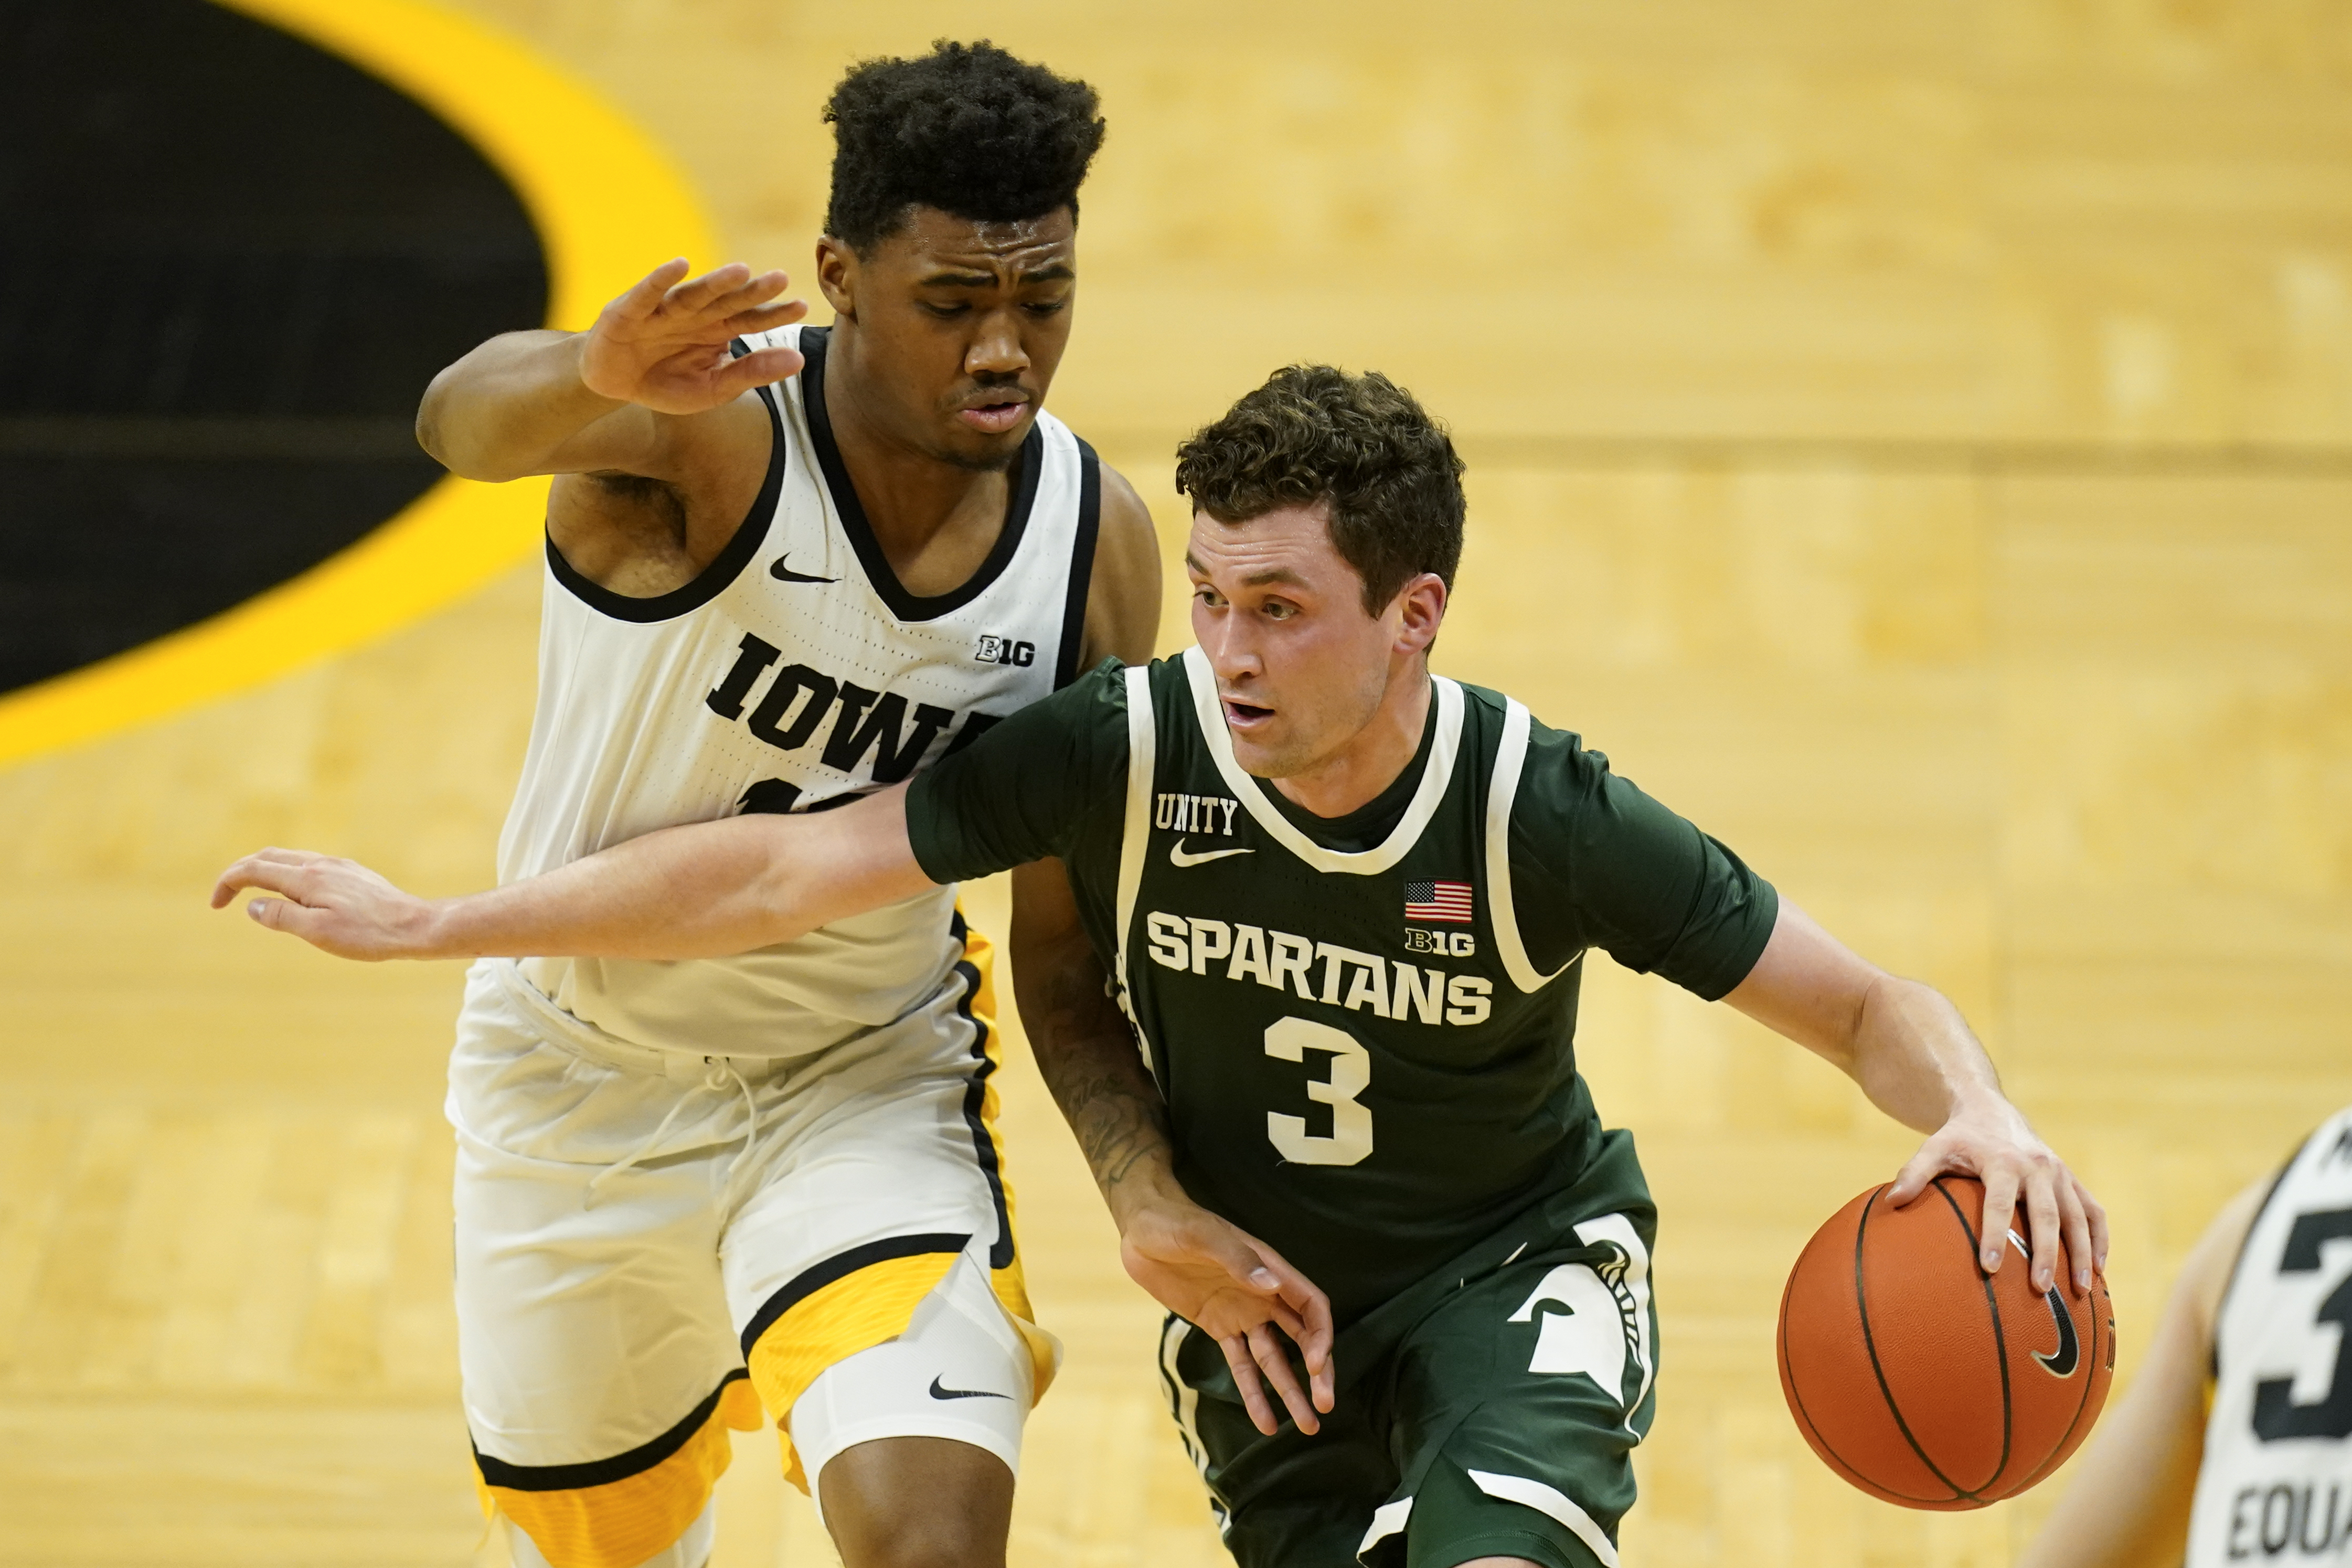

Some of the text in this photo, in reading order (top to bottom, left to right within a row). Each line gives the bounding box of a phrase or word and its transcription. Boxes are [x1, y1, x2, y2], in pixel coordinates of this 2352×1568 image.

[1156, 793, 1238, 836] UNITY
[1147, 911, 1493, 1027] SPARTANS
[1264, 1016, 1374, 1166] 3
